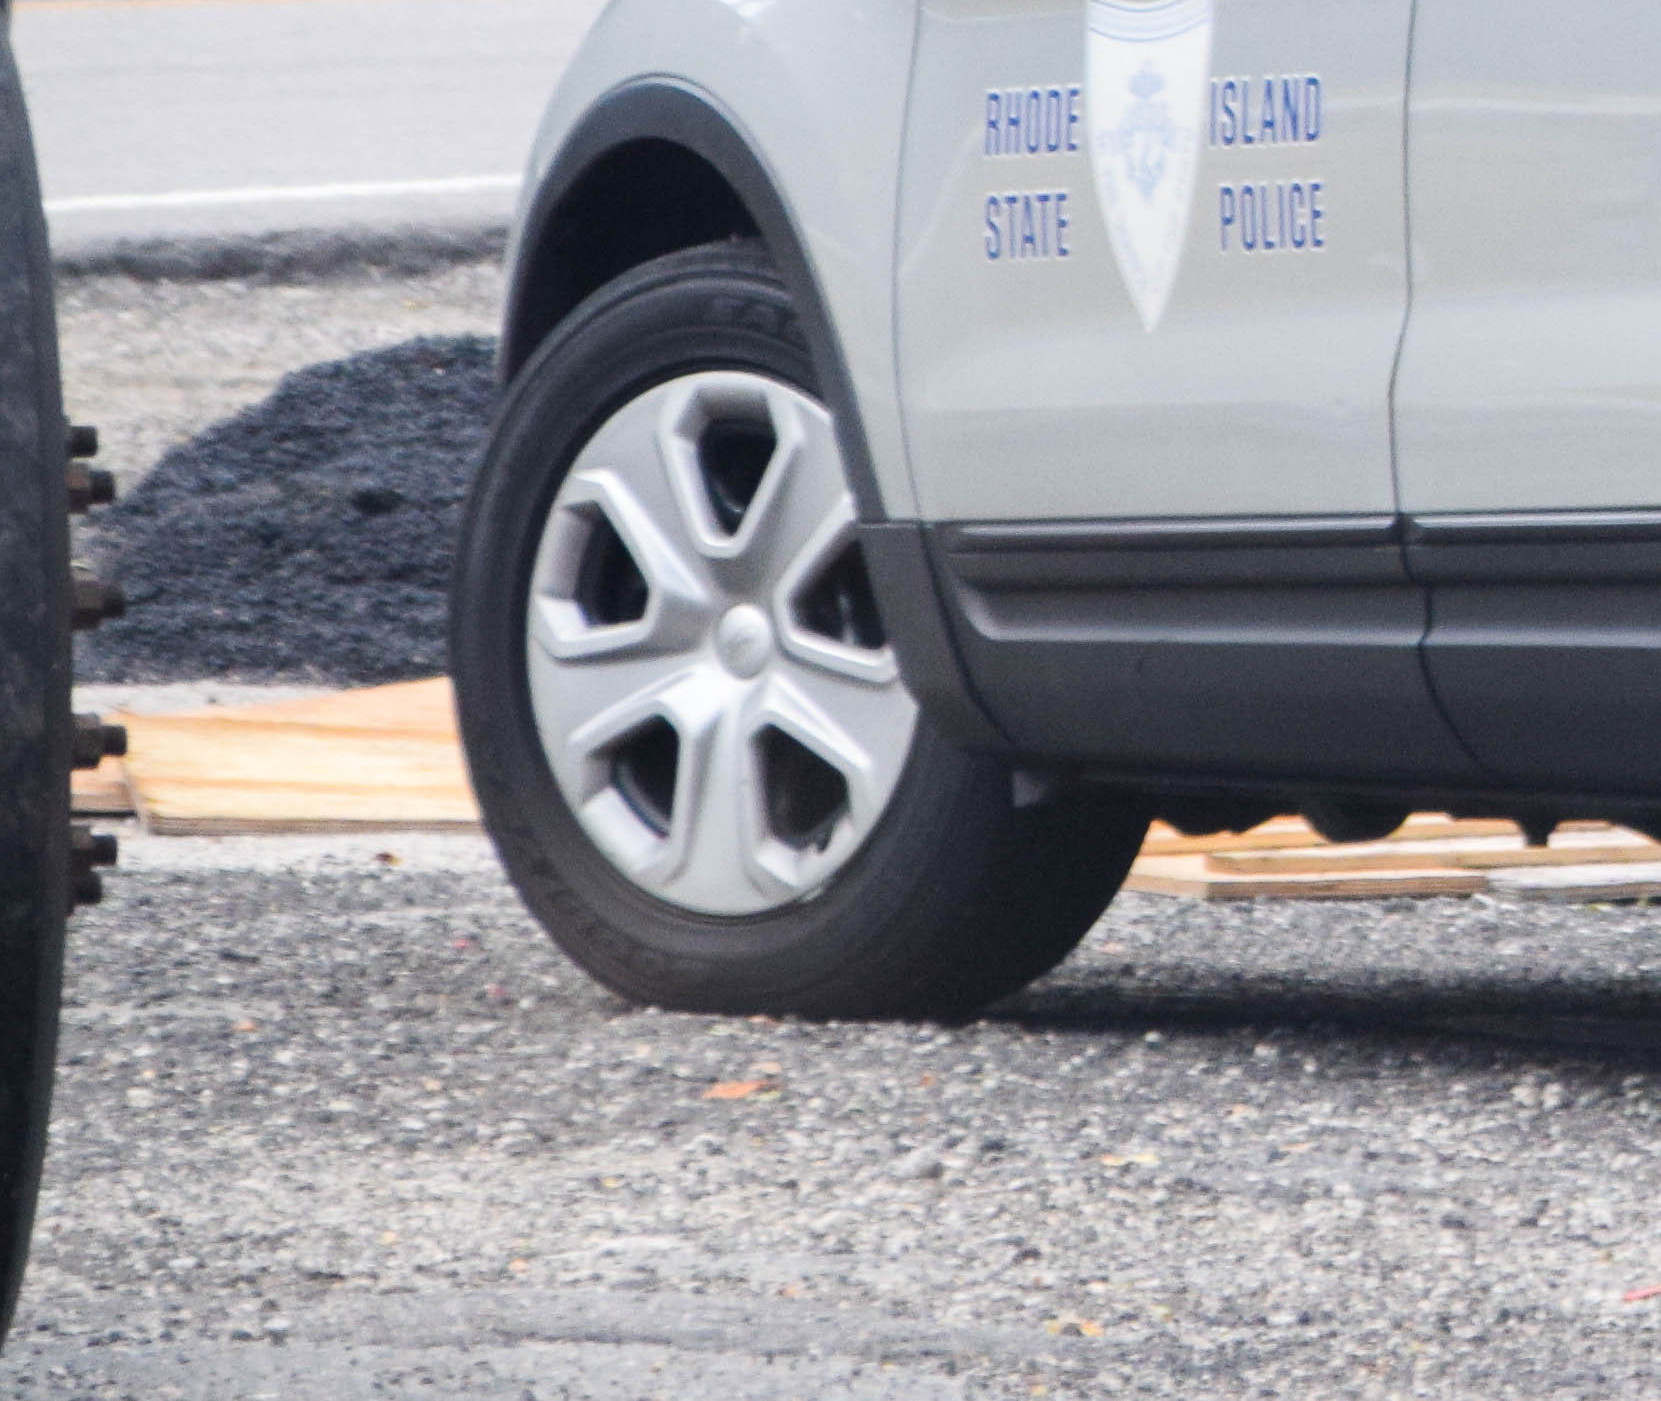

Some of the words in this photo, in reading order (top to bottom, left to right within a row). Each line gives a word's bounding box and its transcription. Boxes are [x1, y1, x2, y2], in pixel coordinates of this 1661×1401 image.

[984, 85, 1082, 156] RHODE
[1207, 74, 1323, 147] ISLAND
[984, 191, 1070, 262] STATE
[1217, 181, 1326, 253] POLICE
